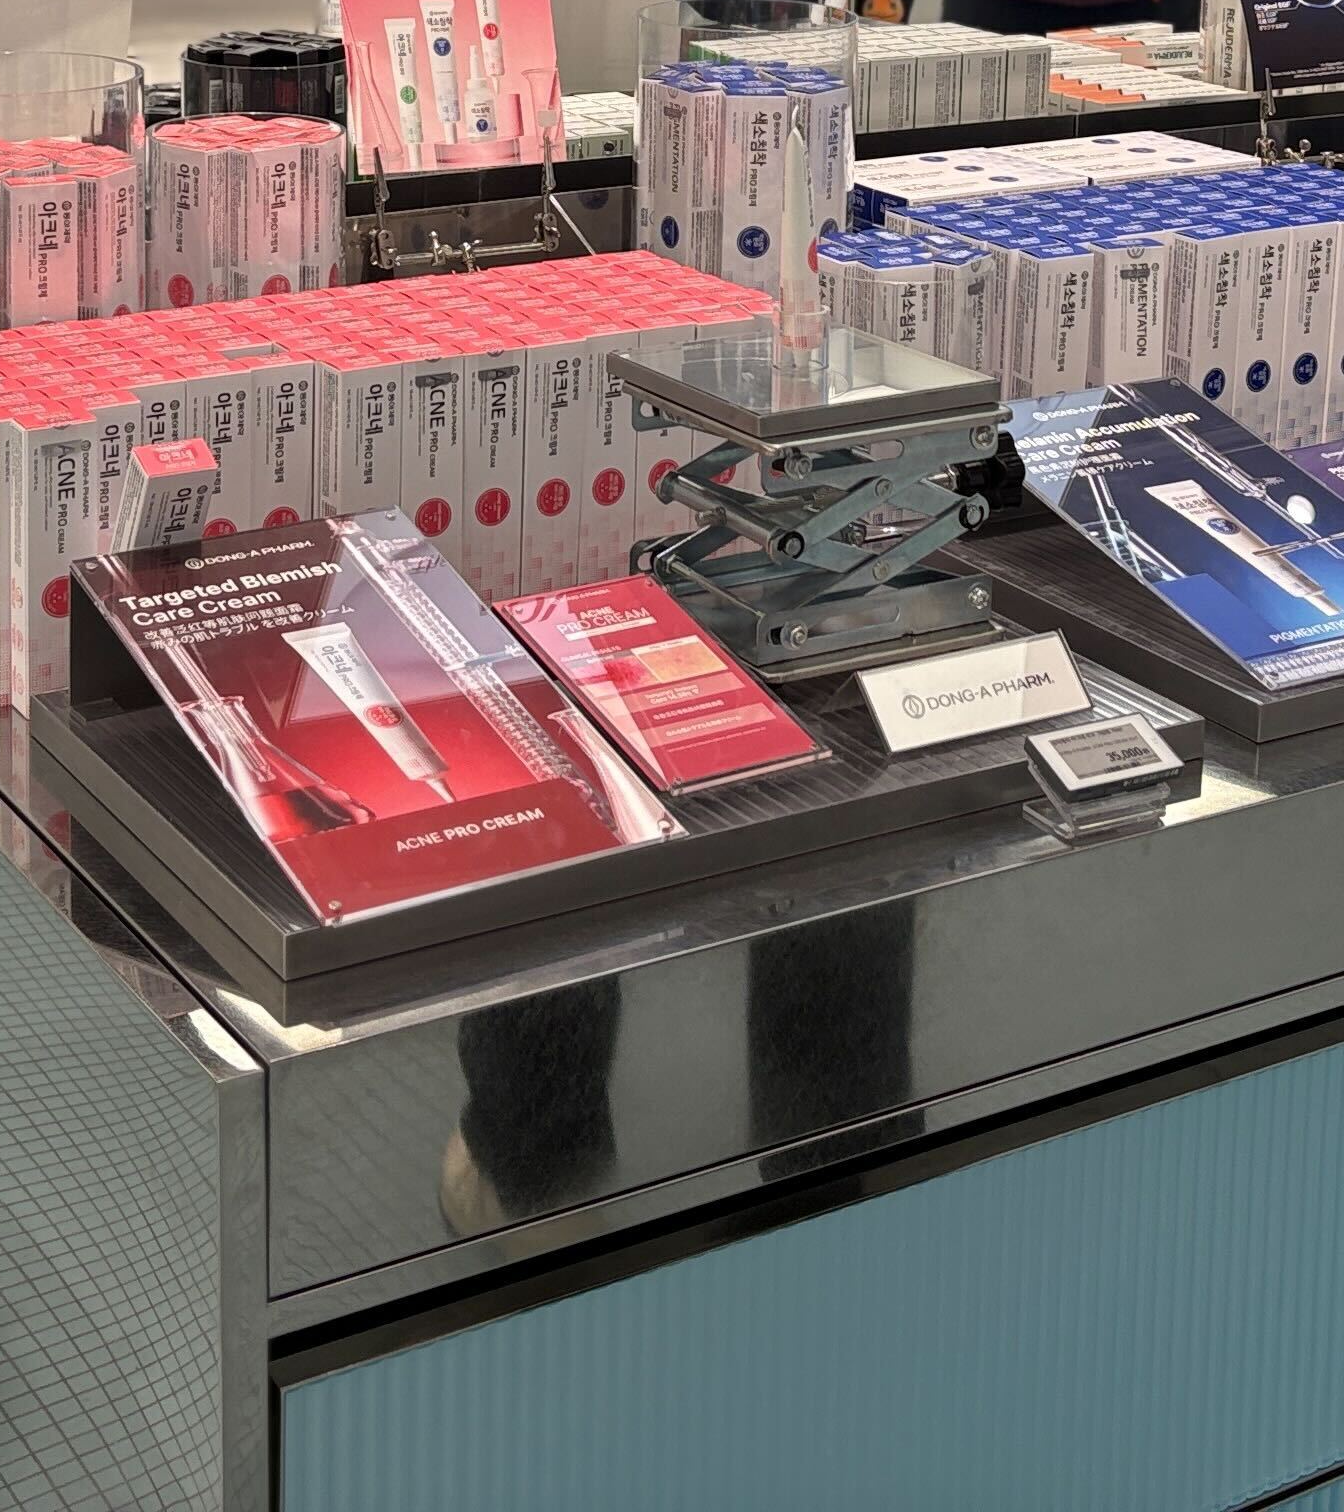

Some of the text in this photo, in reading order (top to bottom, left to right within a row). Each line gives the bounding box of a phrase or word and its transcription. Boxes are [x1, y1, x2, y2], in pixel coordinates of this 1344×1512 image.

[1154, 50, 1193, 61] REJUDERMA
[1223, 7, 1235, 79] REJUDERMA
[750, 111, 769, 167] 색소침착
[176, 163, 190, 210] 아크네
[271, 162, 286, 209] 아크네
[38, 202, 58, 250] 아크네
[116, 187, 127, 236] 아크네
[38, 253, 47, 274] PRO
[1215, 252, 1230, 307] 색소침착
[1259, 244, 1275, 300] 색소침착
[1306, 239, 1323, 294] 색소침착
[900, 283, 916, 343] 색소침착
[1061, 271, 1077, 330] 색소침착
[1137, 263, 1150, 357] PGMENTATION
[213, 392, 232, 445] 아크네
[276, 382, 295, 434] 아크네
[364, 383, 384, 436] 아크네
[429, 375, 445, 429] ACNE
[489, 370, 507, 469] ACNE PRO CREAM
[549, 360, 569, 433] 아크네 PRO
[604, 401, 613, 423] PRO
[99, 424, 120, 480] 아크네
[275, 436, 284, 458] PRO
[364, 438, 373, 460] PRO
[429, 431, 438, 453] PRO
[1015, 411, 1201, 451] elanin Accumulation
[1060, 438, 1123, 456] Cream
[57, 444, 75, 502] ACNE
[99, 481, 110, 504] PRO
[57, 503, 67, 527] PRO
[164, 488, 191, 533] 아크네
[203, 539, 316, 567] DONG-A PHARM.
[119, 560, 344, 612] Targeted Blemish
[131, 590, 283, 627] Care Cream
[556, 606, 651, 636] PRO CREAM
[321, 645, 353, 674] 아크네
[927, 671, 1056, 712] DONG-A PHARM.
[396, 807, 546, 853] ACNE PRO CREAM
